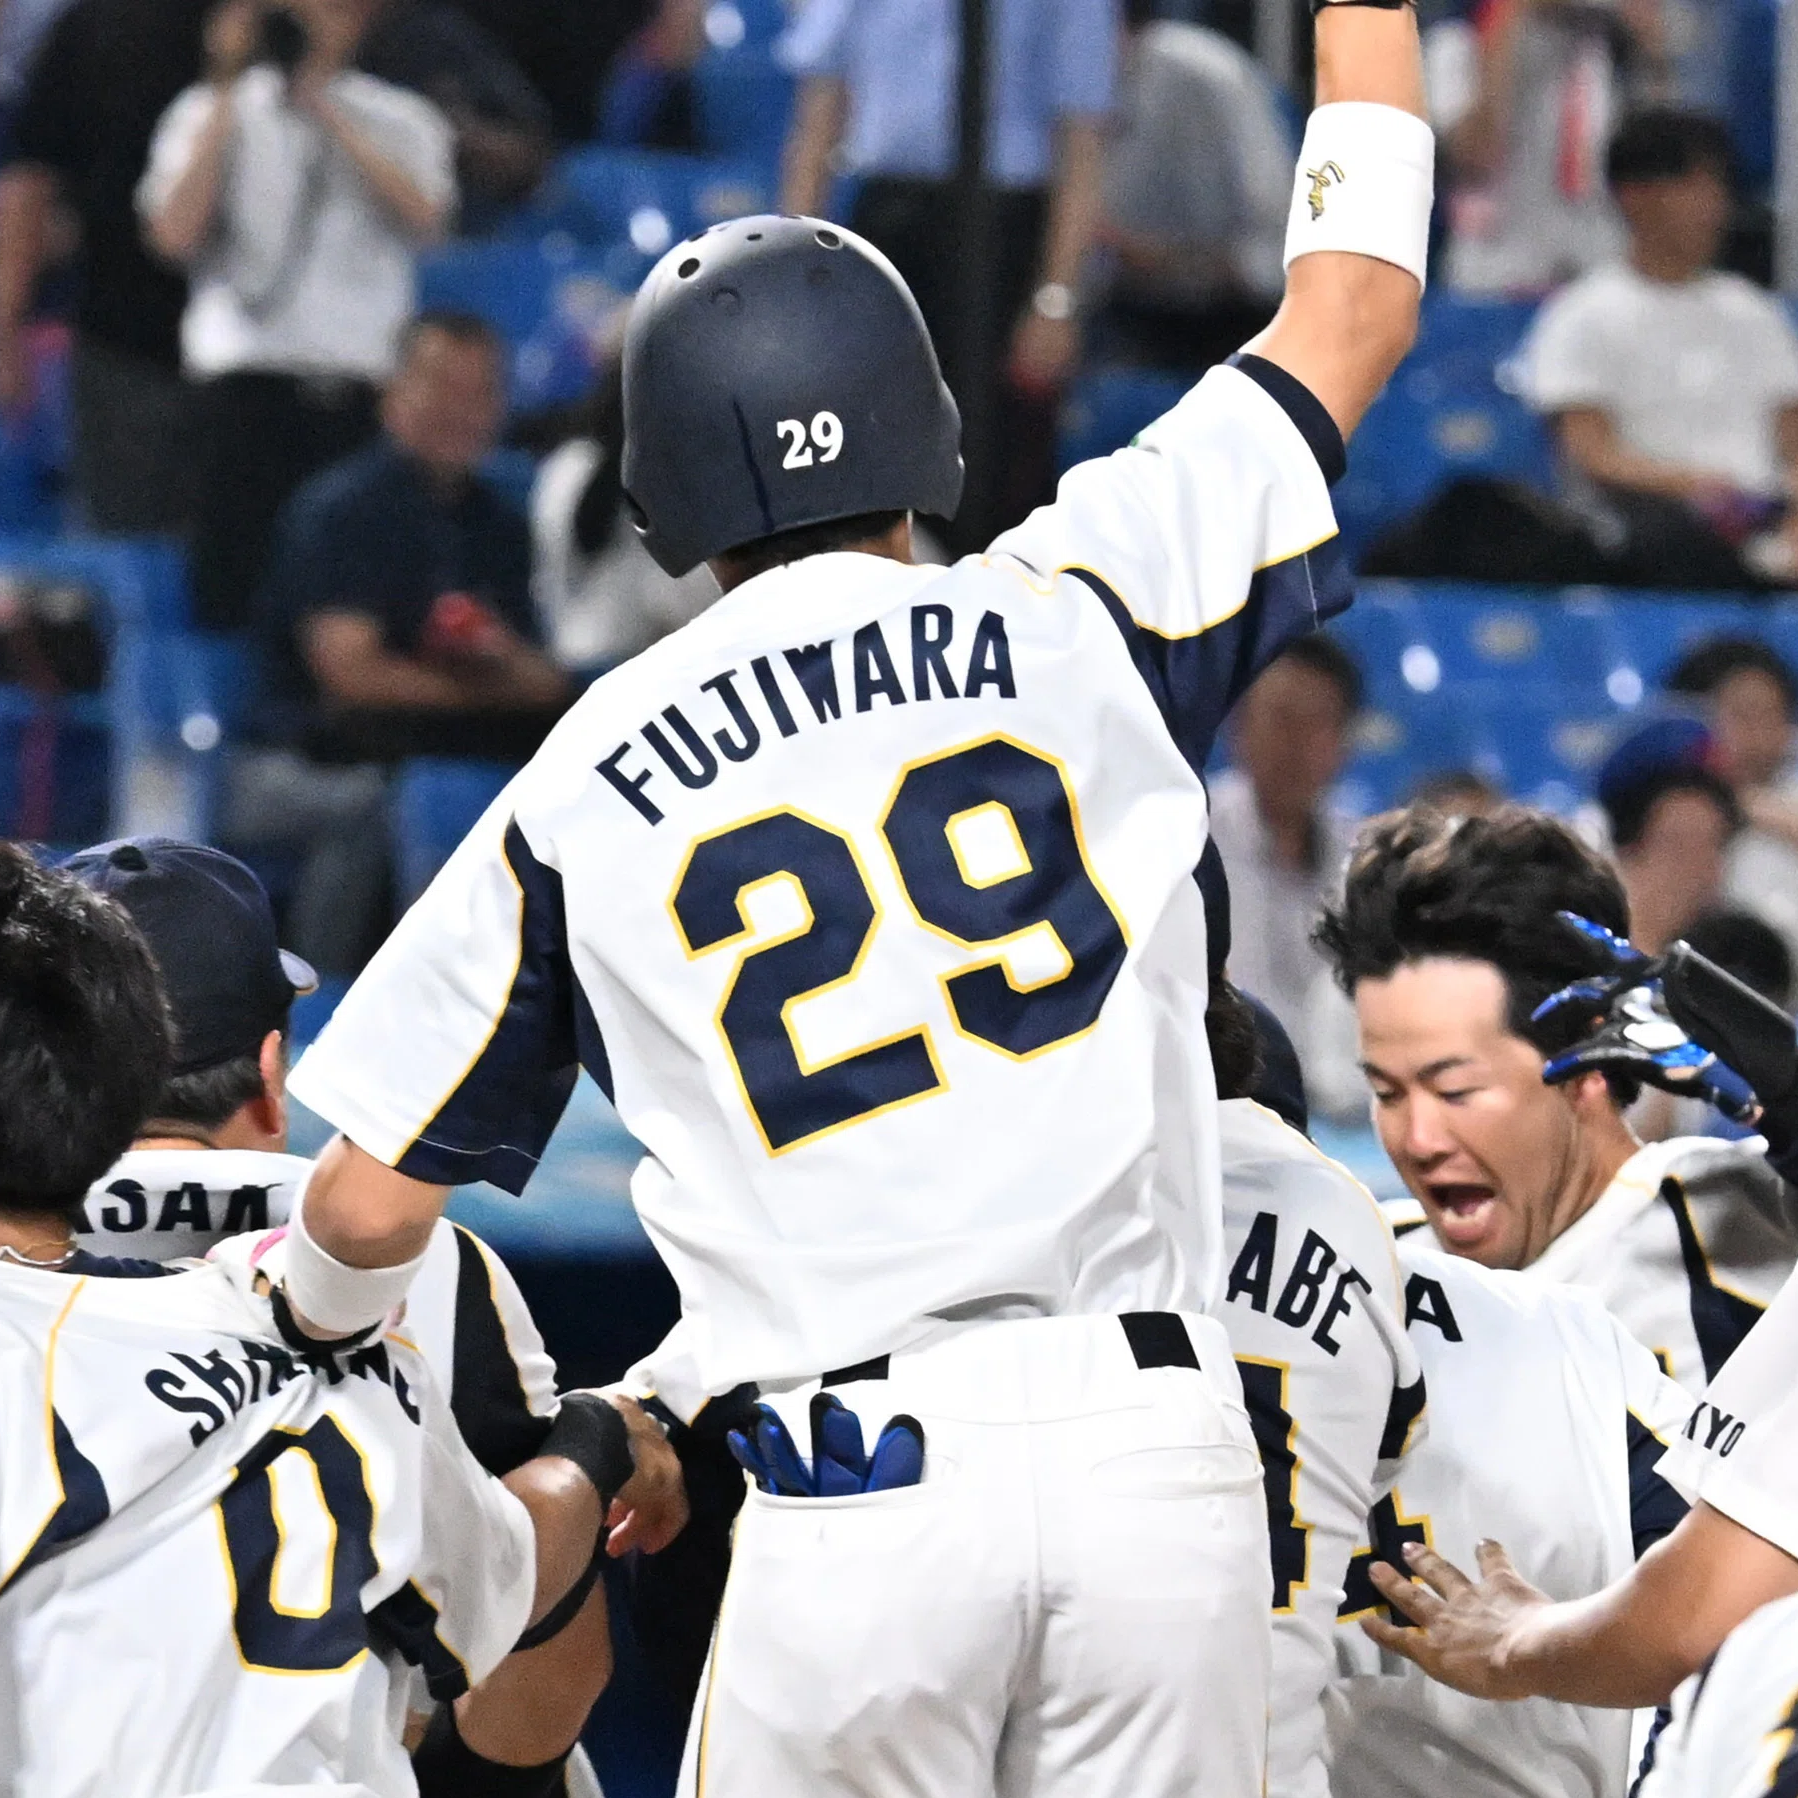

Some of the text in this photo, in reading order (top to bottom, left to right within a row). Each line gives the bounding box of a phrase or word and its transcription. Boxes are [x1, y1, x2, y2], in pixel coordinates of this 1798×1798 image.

[776, 410, 845, 470] 29
[594, 603, 1018, 827] FUJIWARA
[664, 731, 1132, 1157] 29
[211, 1409, 382, 1678] 0
